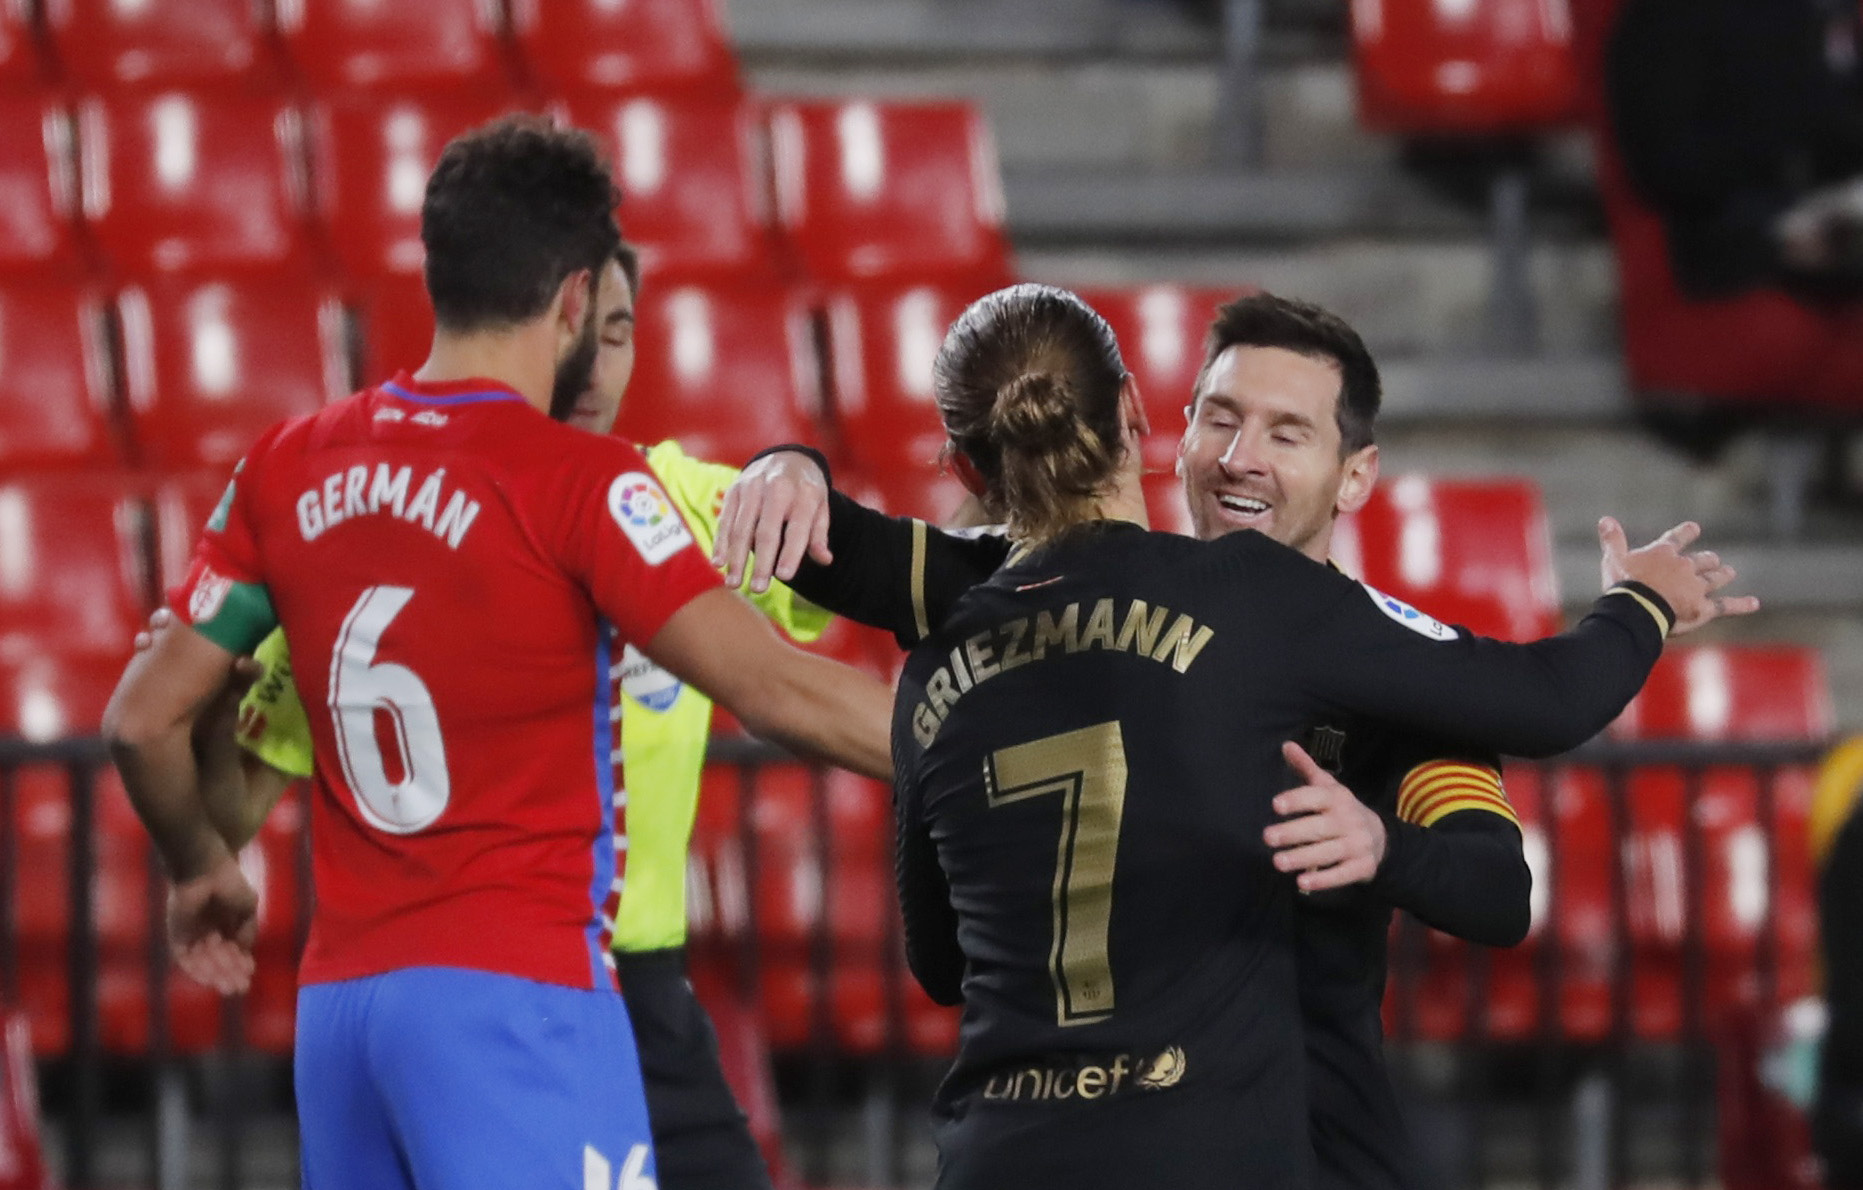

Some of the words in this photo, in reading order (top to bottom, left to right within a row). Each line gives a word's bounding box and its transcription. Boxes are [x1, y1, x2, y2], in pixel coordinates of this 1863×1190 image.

[297, 462, 480, 550] GERMÁN
[328, 584, 450, 835] 6
[912, 597, 1215, 749] GRIEZMANN
[983, 719, 1129, 1028] 7
[983, 1053, 1129, 1101] unicef
